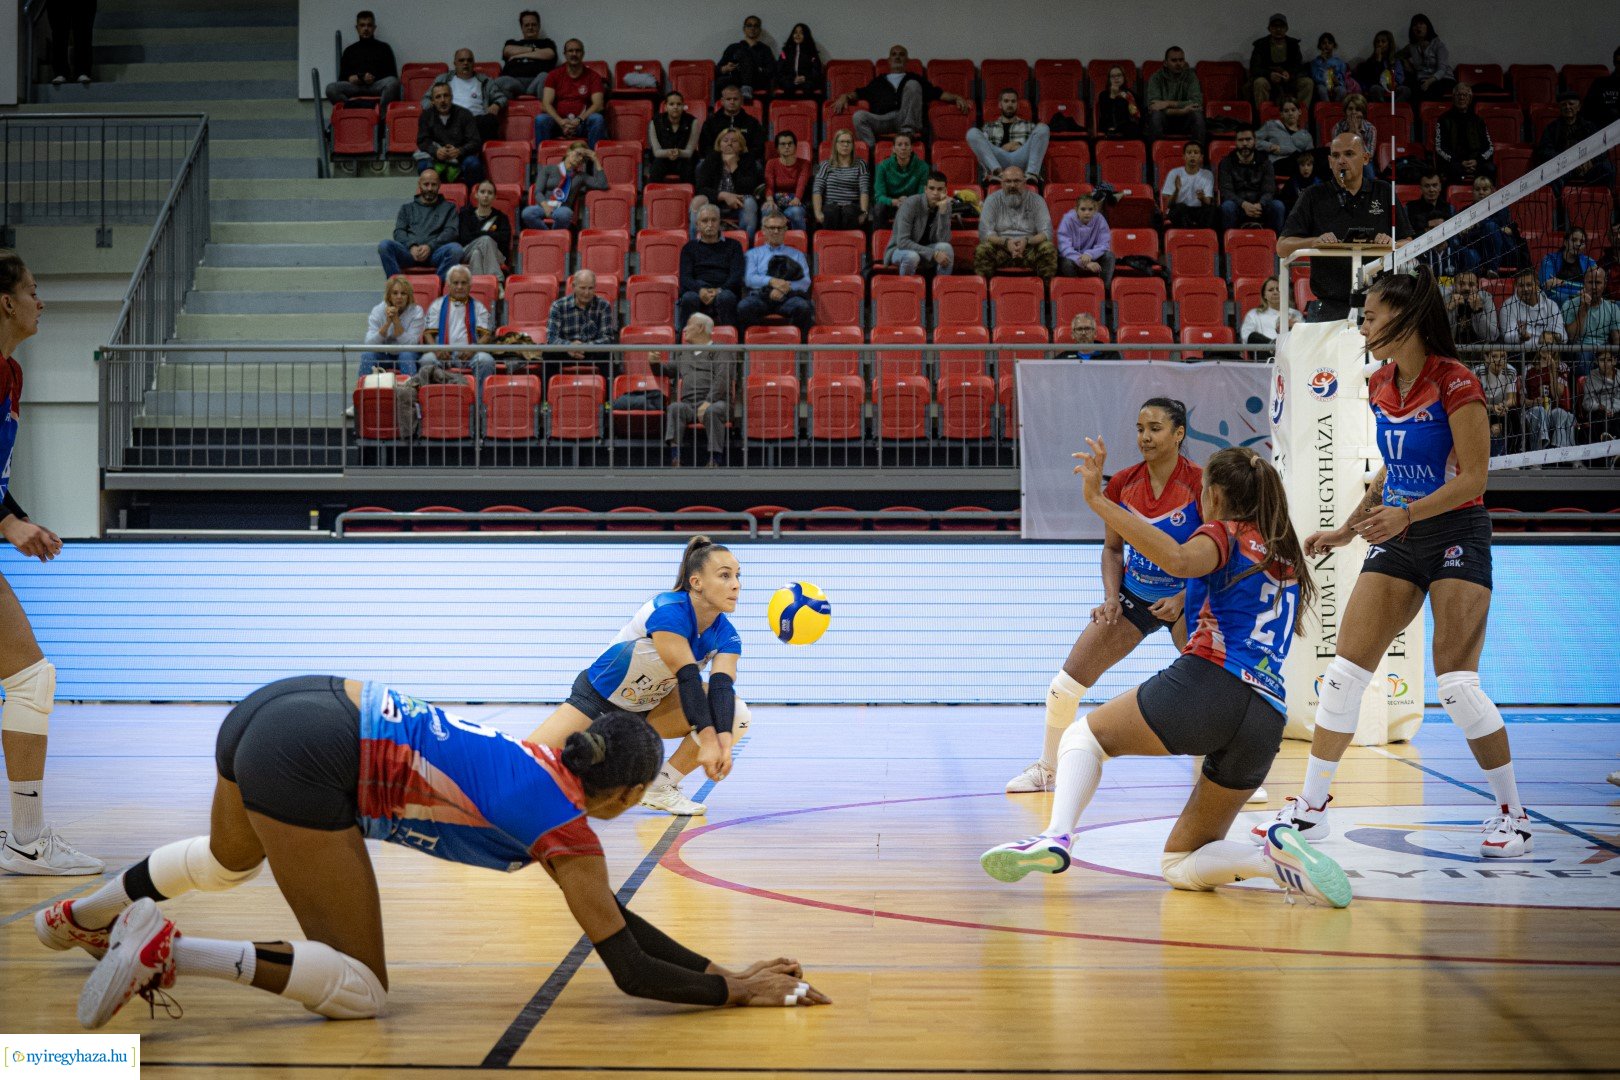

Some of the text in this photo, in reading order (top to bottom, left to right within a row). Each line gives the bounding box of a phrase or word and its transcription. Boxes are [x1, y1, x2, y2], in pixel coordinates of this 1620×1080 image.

[1384, 429, 1407, 460] 17
[1386, 463, 1436, 479] ATUM
[1315, 413, 1336, 660] FATUM-NREGYHÁZA
[1251, 582, 1295, 654] 21
